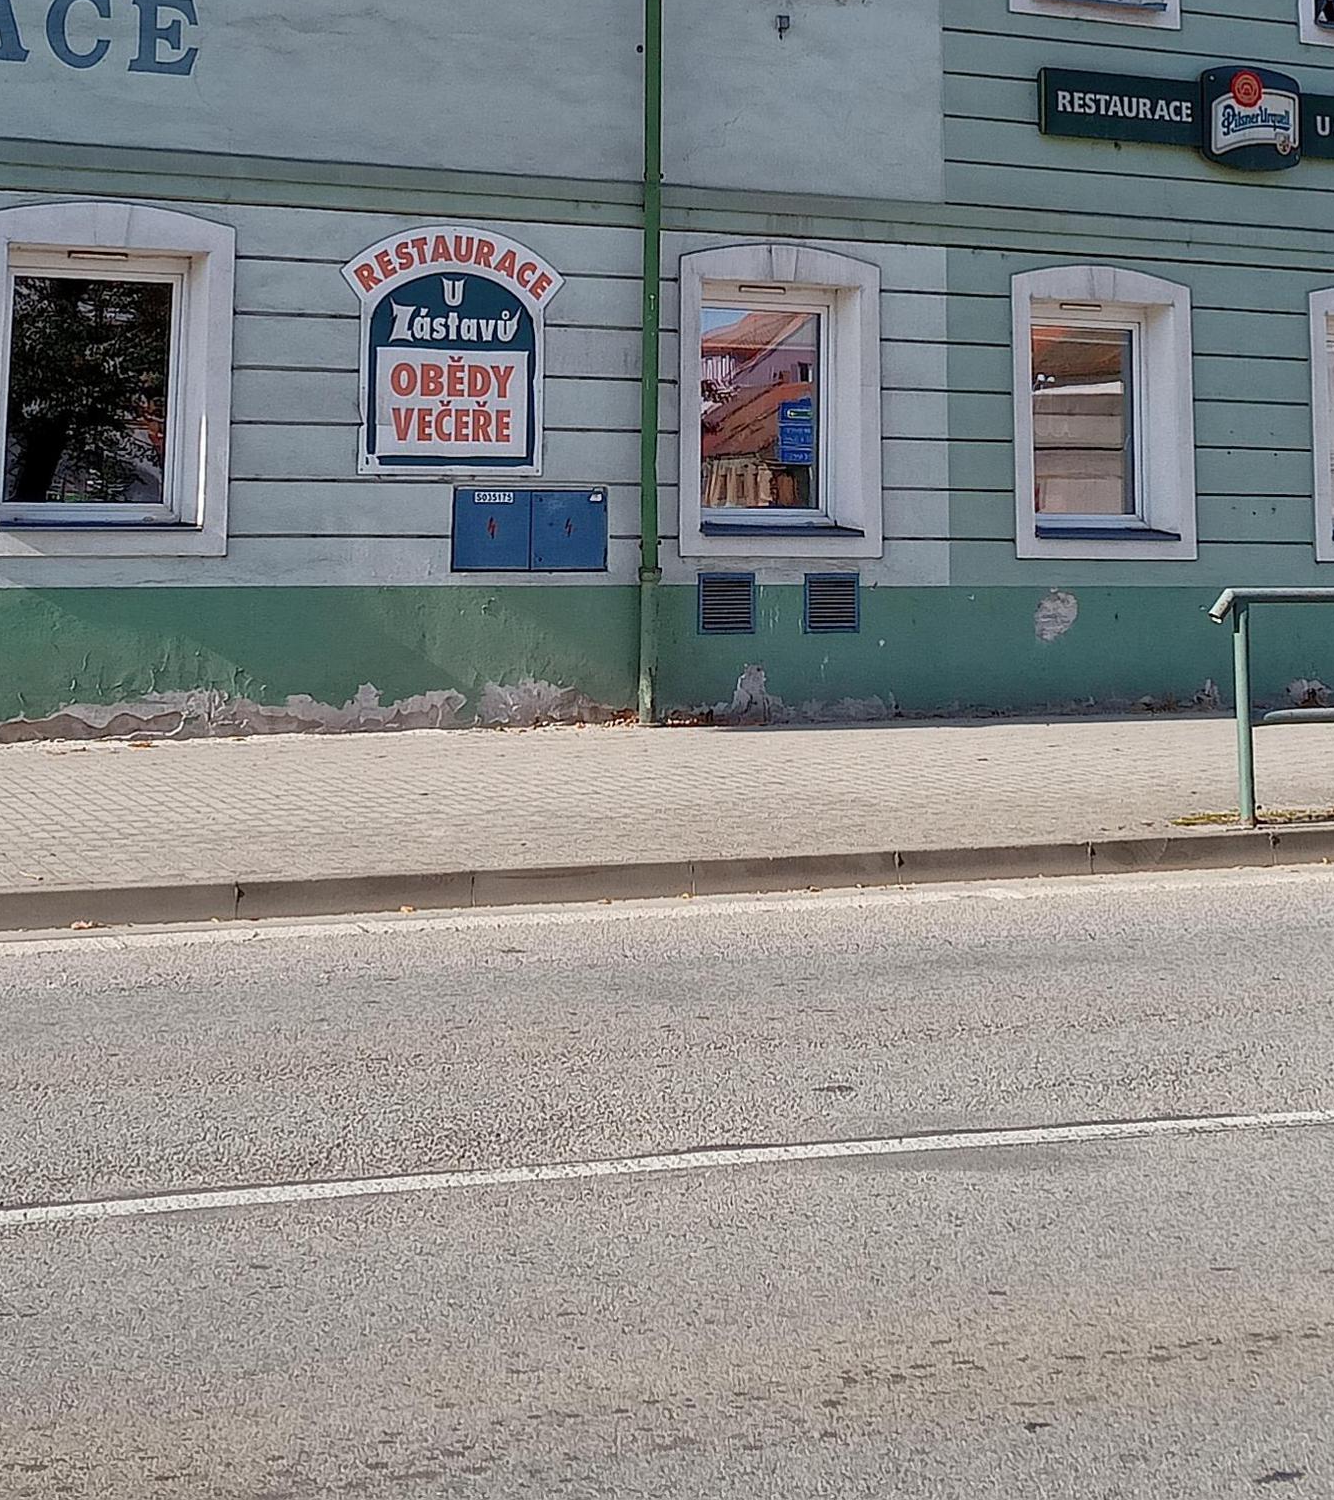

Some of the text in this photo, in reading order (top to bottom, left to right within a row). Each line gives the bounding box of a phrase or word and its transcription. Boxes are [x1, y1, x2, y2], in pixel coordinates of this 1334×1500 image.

[1056, 90, 1193, 123] RESTAURACE
[1221, 104, 1291, 136] Pilsner Urquell
[1315, 115, 1331, 136] U
[352, 235, 554, 301] RESTAURACE
[440, 276, 466, 307] U
[388, 296, 524, 343] Zástavů
[390, 355, 516, 399] OBĚDY
[391, 400, 512, 443] VEČEŘE
